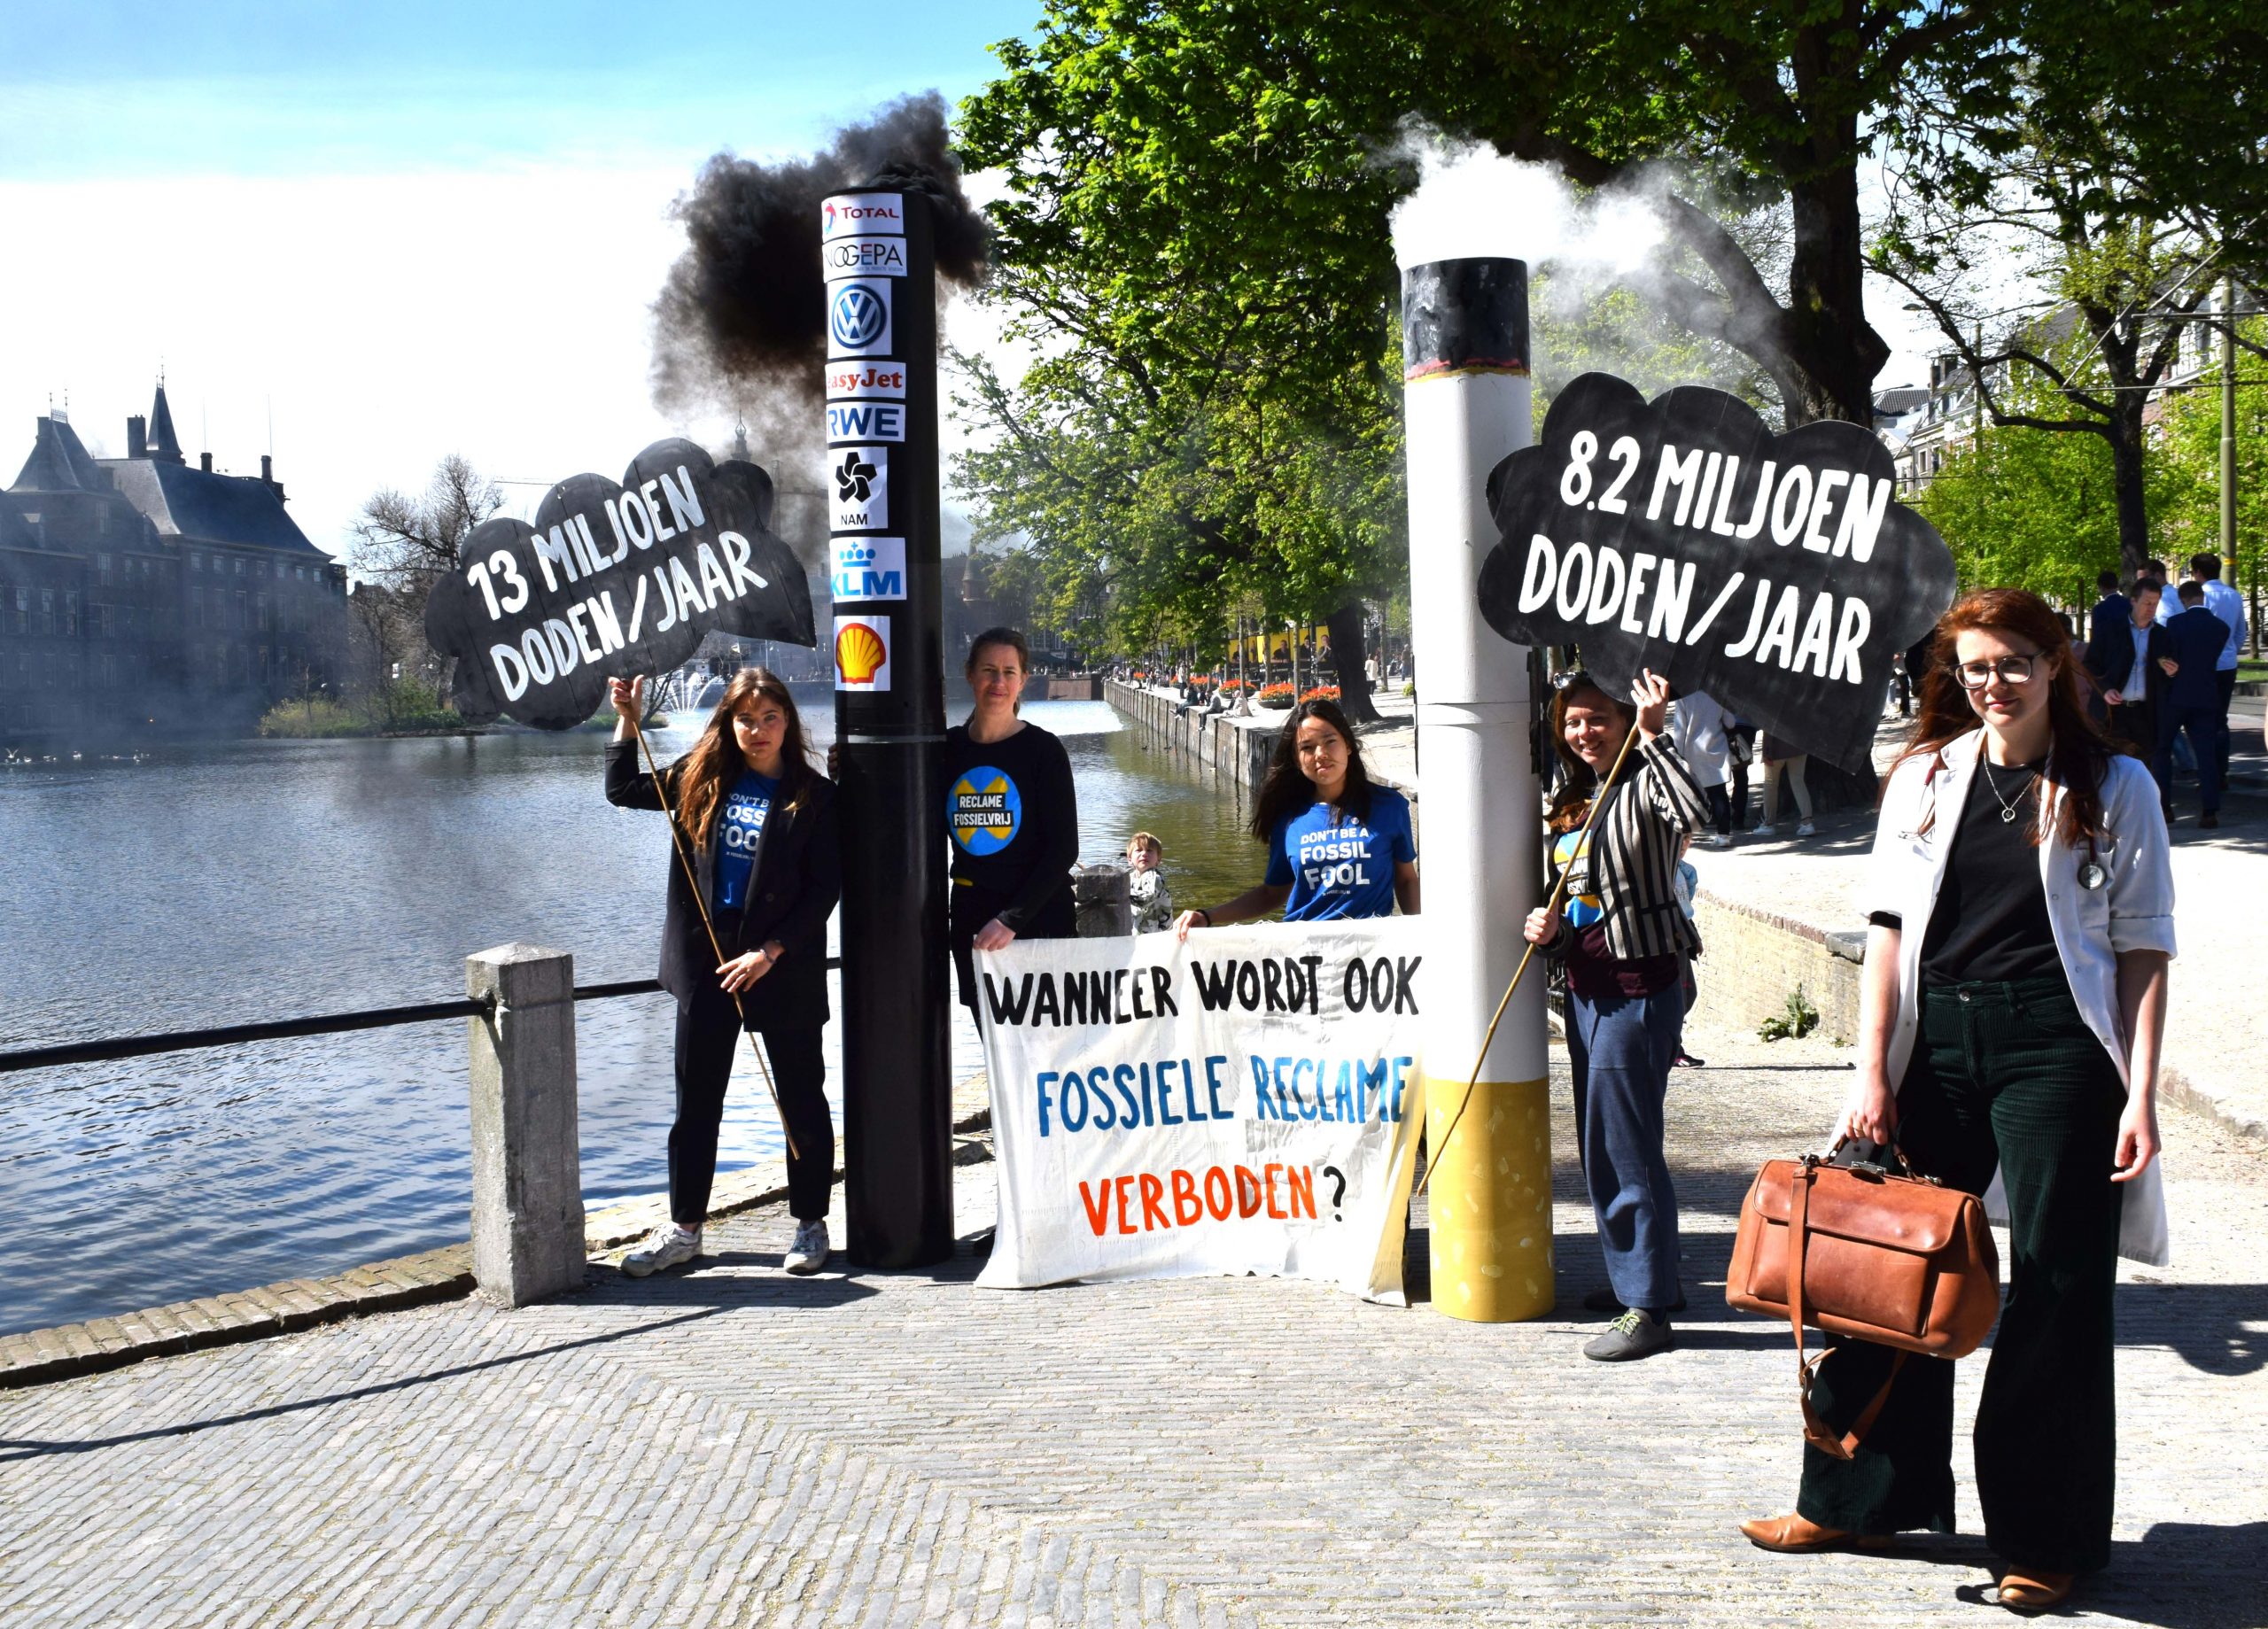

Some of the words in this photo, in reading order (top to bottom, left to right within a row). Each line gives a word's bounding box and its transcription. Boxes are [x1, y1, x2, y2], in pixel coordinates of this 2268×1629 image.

[841, 206, 899, 220] TOTAL
[827, 407, 899, 437] RWE
[1559, 431, 1641, 515] 8.2
[1646, 444, 1891, 562] MILJOEN
[840, 513, 868, 525] NAM
[467, 550, 529, 621] 13
[530, 465, 705, 593] MILJOEN
[831, 570, 901, 597] KLM
[729, 793, 760, 807] ON'T
[959, 795, 1003, 808] RECLAME
[726, 803, 767, 826] OSS
[953, 812, 1011, 826] FOSSIELVRIJ
[722, 825, 760, 851] OO
[1300, 829, 1339, 845] DON'T
[1340, 827, 1357, 839] BE
[1359, 827, 1370, 838] A
[1300, 841, 1371, 865] FOSSIL
[1304, 863, 1371, 890] FOOL
[983, 966, 1179, 1027] WANNEER
[1191, 956, 1324, 1014] WORDT
[1343, 956, 1425, 1015] OOK
[1037, 1055, 1235, 1137] FOSSIELE
[1250, 1055, 1414, 1124] RECLAME
